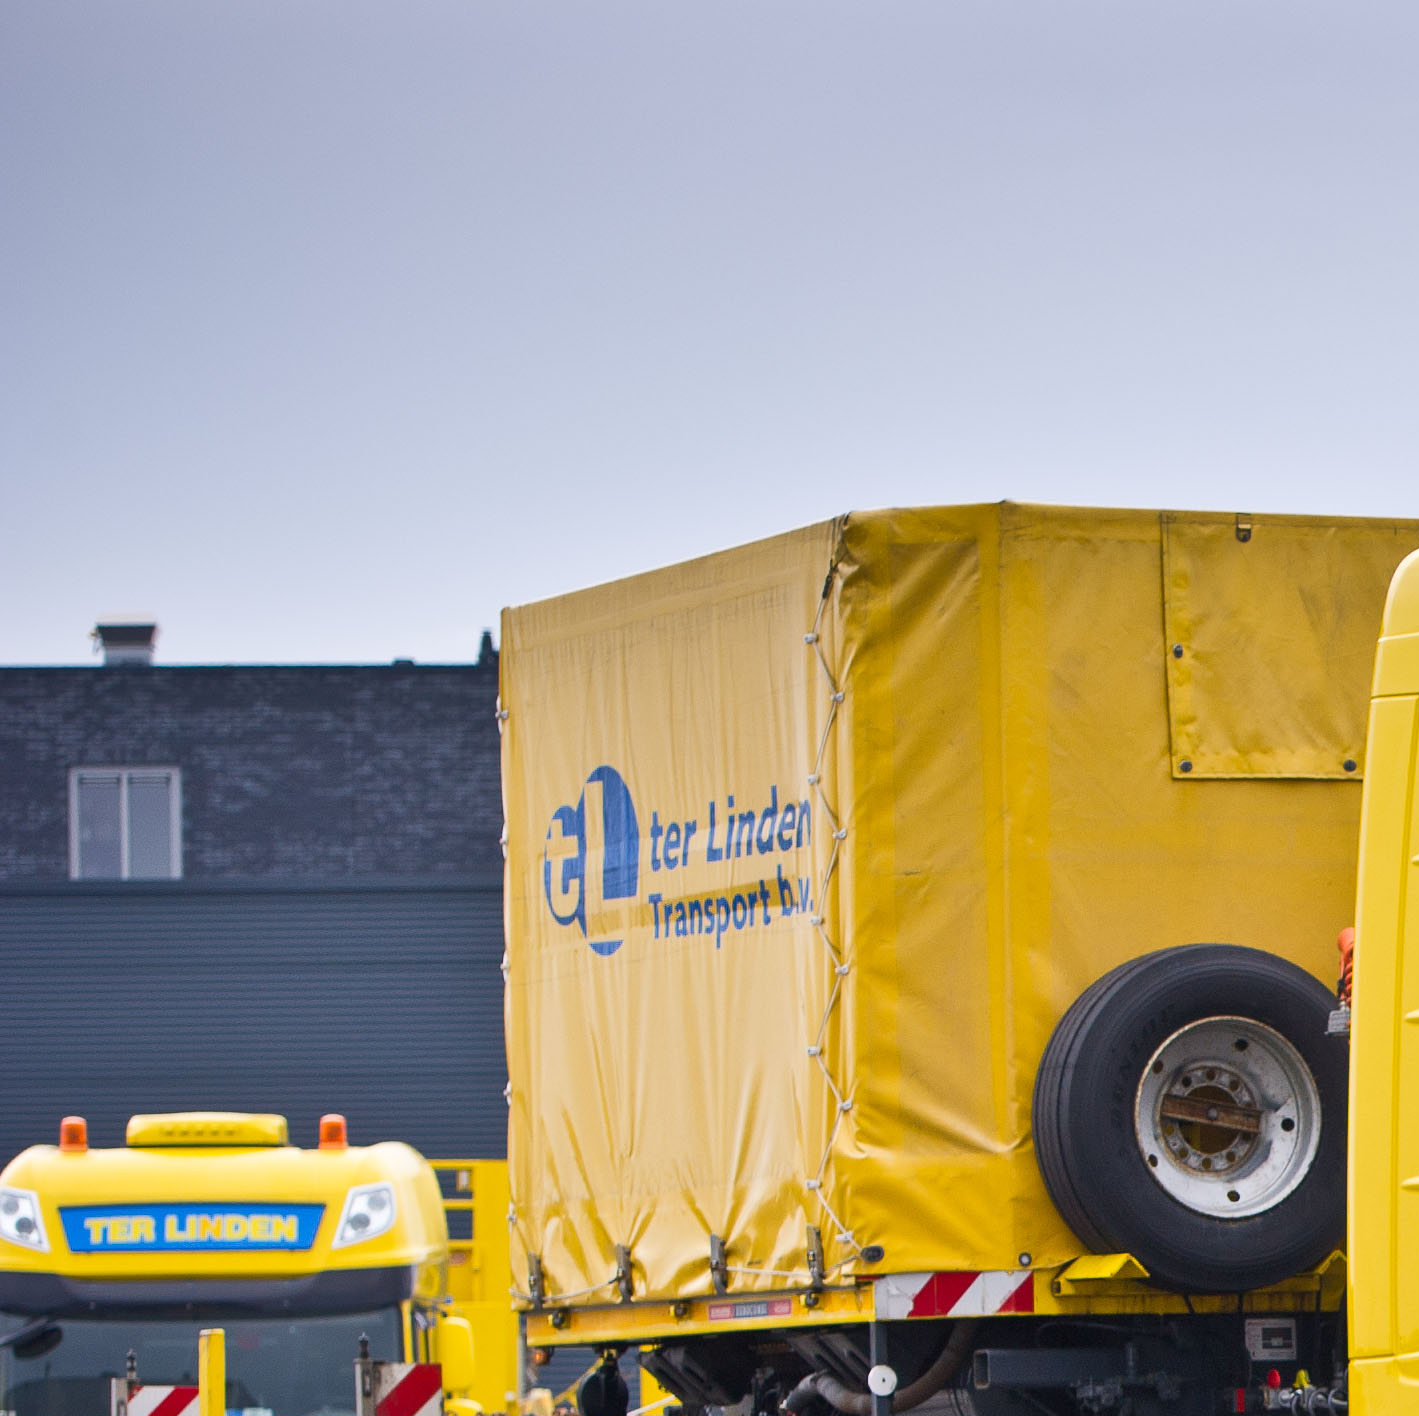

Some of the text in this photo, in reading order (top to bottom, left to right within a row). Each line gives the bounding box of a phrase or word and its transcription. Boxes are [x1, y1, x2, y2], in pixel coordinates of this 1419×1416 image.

[649, 785, 812, 873] ter Linden
[648, 865, 815, 949] Transport b.v.
[84, 1214, 299, 1245] TER LINDEN
